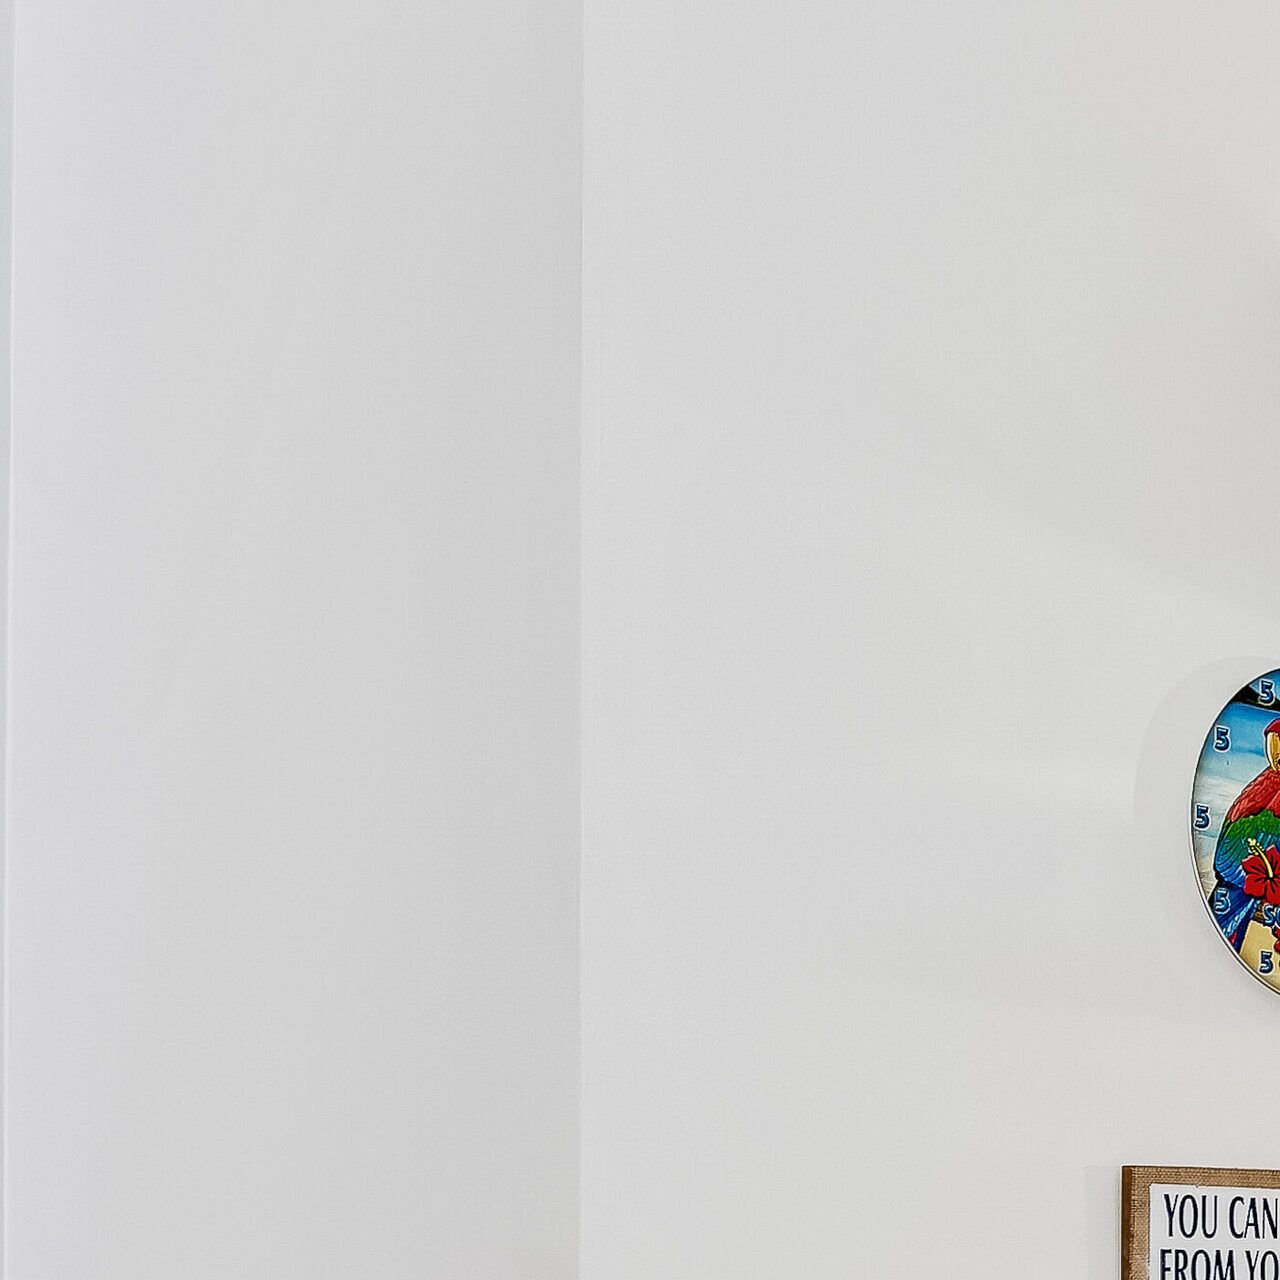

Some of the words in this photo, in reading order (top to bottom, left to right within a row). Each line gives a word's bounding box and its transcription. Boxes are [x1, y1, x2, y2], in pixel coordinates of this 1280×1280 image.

[1260, 681, 1273, 704] 5
[1215, 727, 1231, 751] 5
[1195, 805, 1210, 829] 5
[1215, 889, 1231, 913] 5
[1260, 952, 1273, 973] 5
[1163, 1193, 1218, 1239] YOU
[1229, 1196, 1279, 1240] CAN
